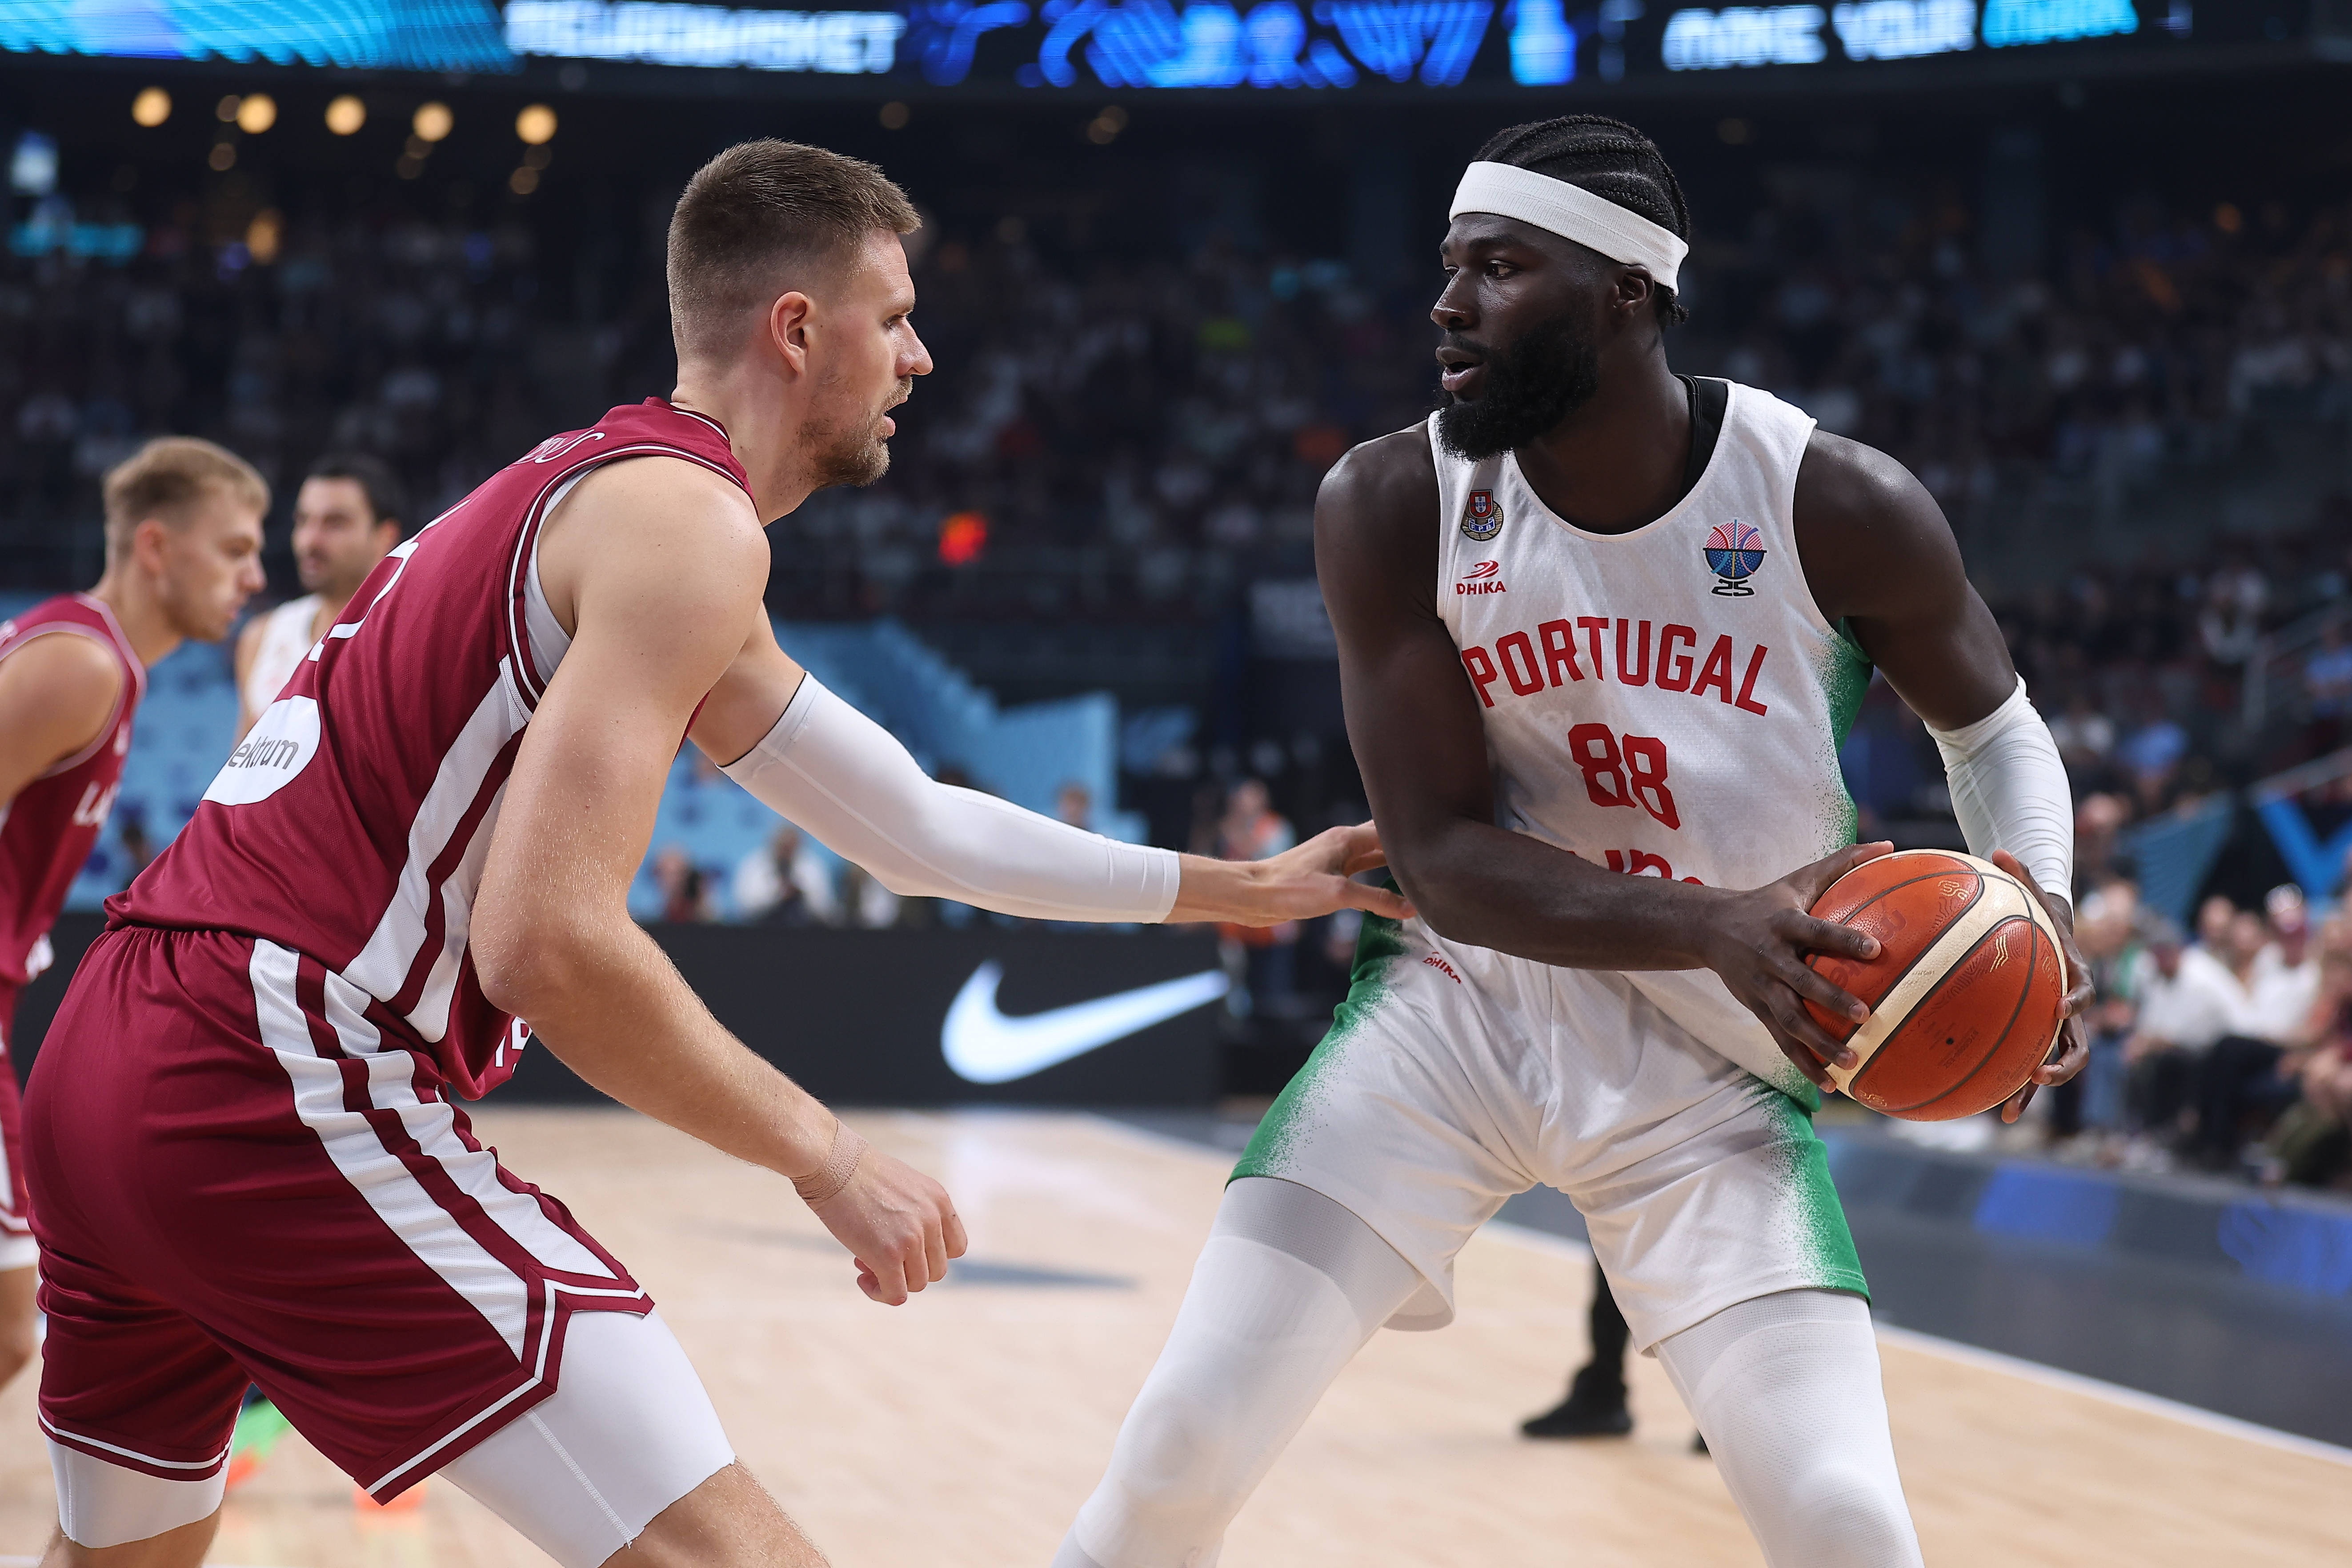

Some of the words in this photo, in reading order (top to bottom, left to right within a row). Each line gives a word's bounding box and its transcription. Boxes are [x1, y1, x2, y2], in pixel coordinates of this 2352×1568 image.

[1456, 581, 1506, 595] DHIKA
[1711, 579, 1755, 596] 25
[1461, 616, 1768, 716] PORTUGAL
[228, 736, 299, 770] ektrum
[1568, 723, 1681, 830] 88
